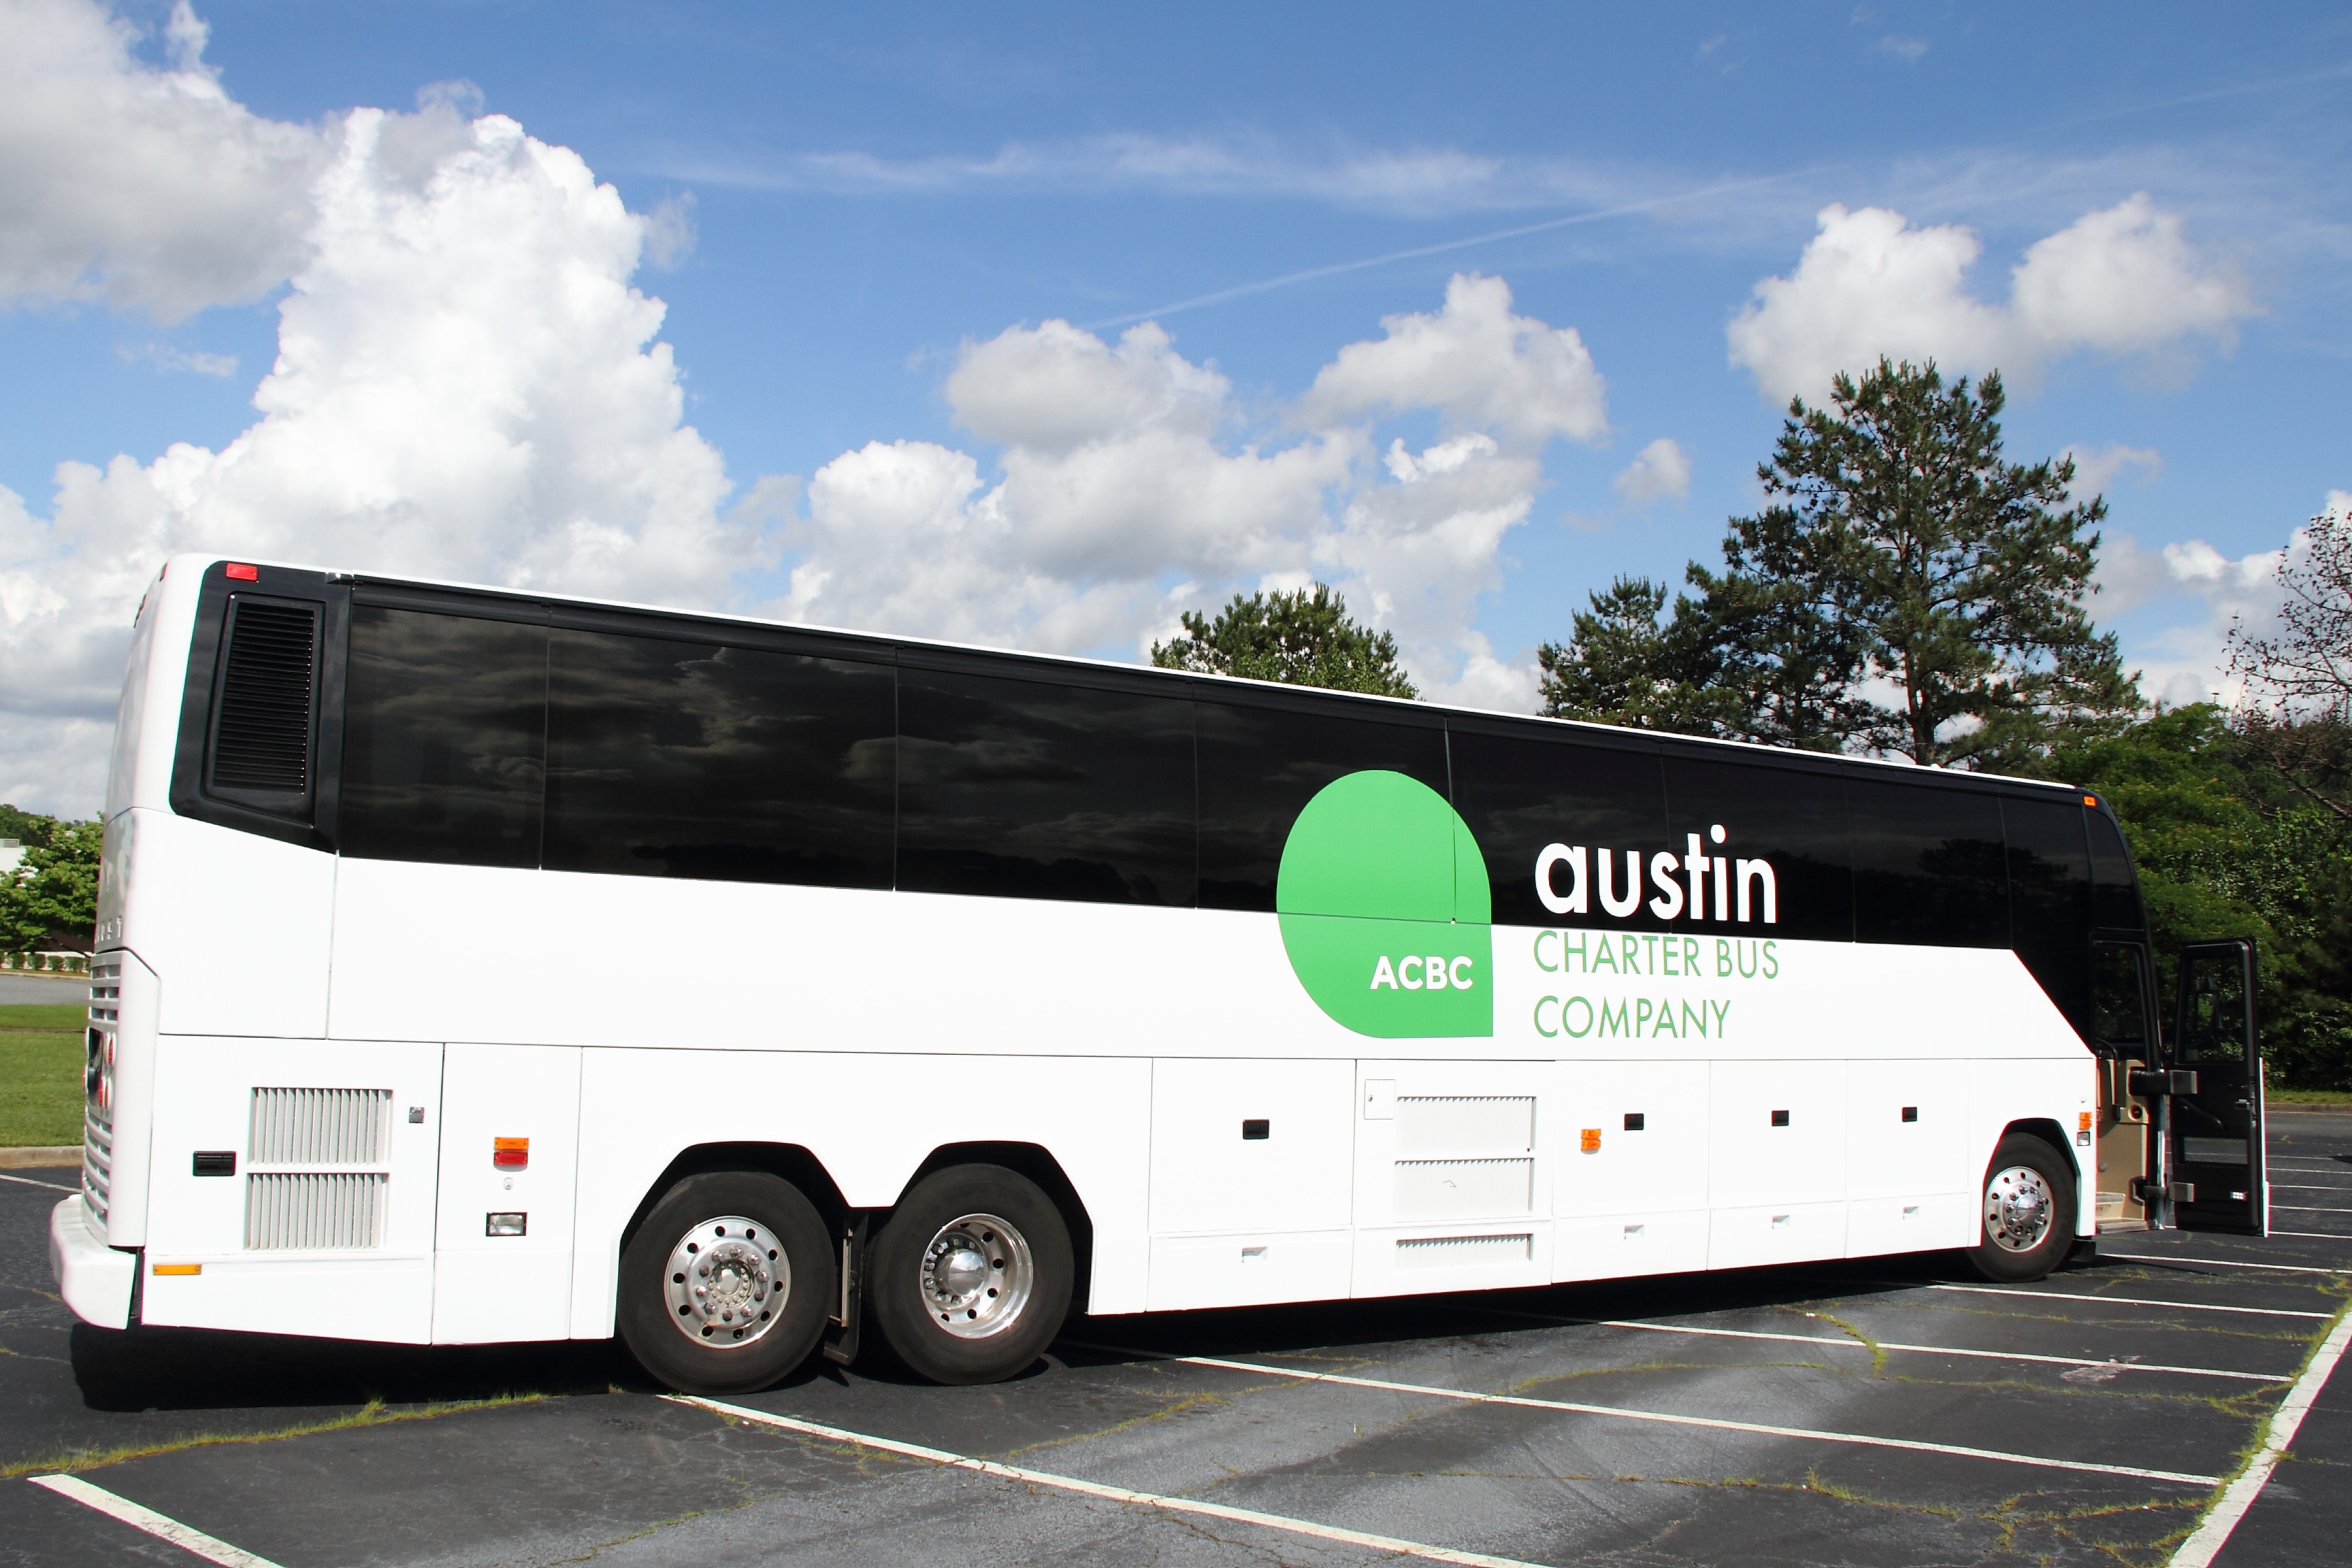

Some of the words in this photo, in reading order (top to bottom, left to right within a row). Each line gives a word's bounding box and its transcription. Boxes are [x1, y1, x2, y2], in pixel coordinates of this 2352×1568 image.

[1535, 824, 1777, 923] austin
[1369, 955, 1474, 990] ACBC
[1534, 930, 1701, 977] CHARTER
[1717, 939, 1779, 979] BUS
[1534, 996, 1731, 1038] COMPANY
